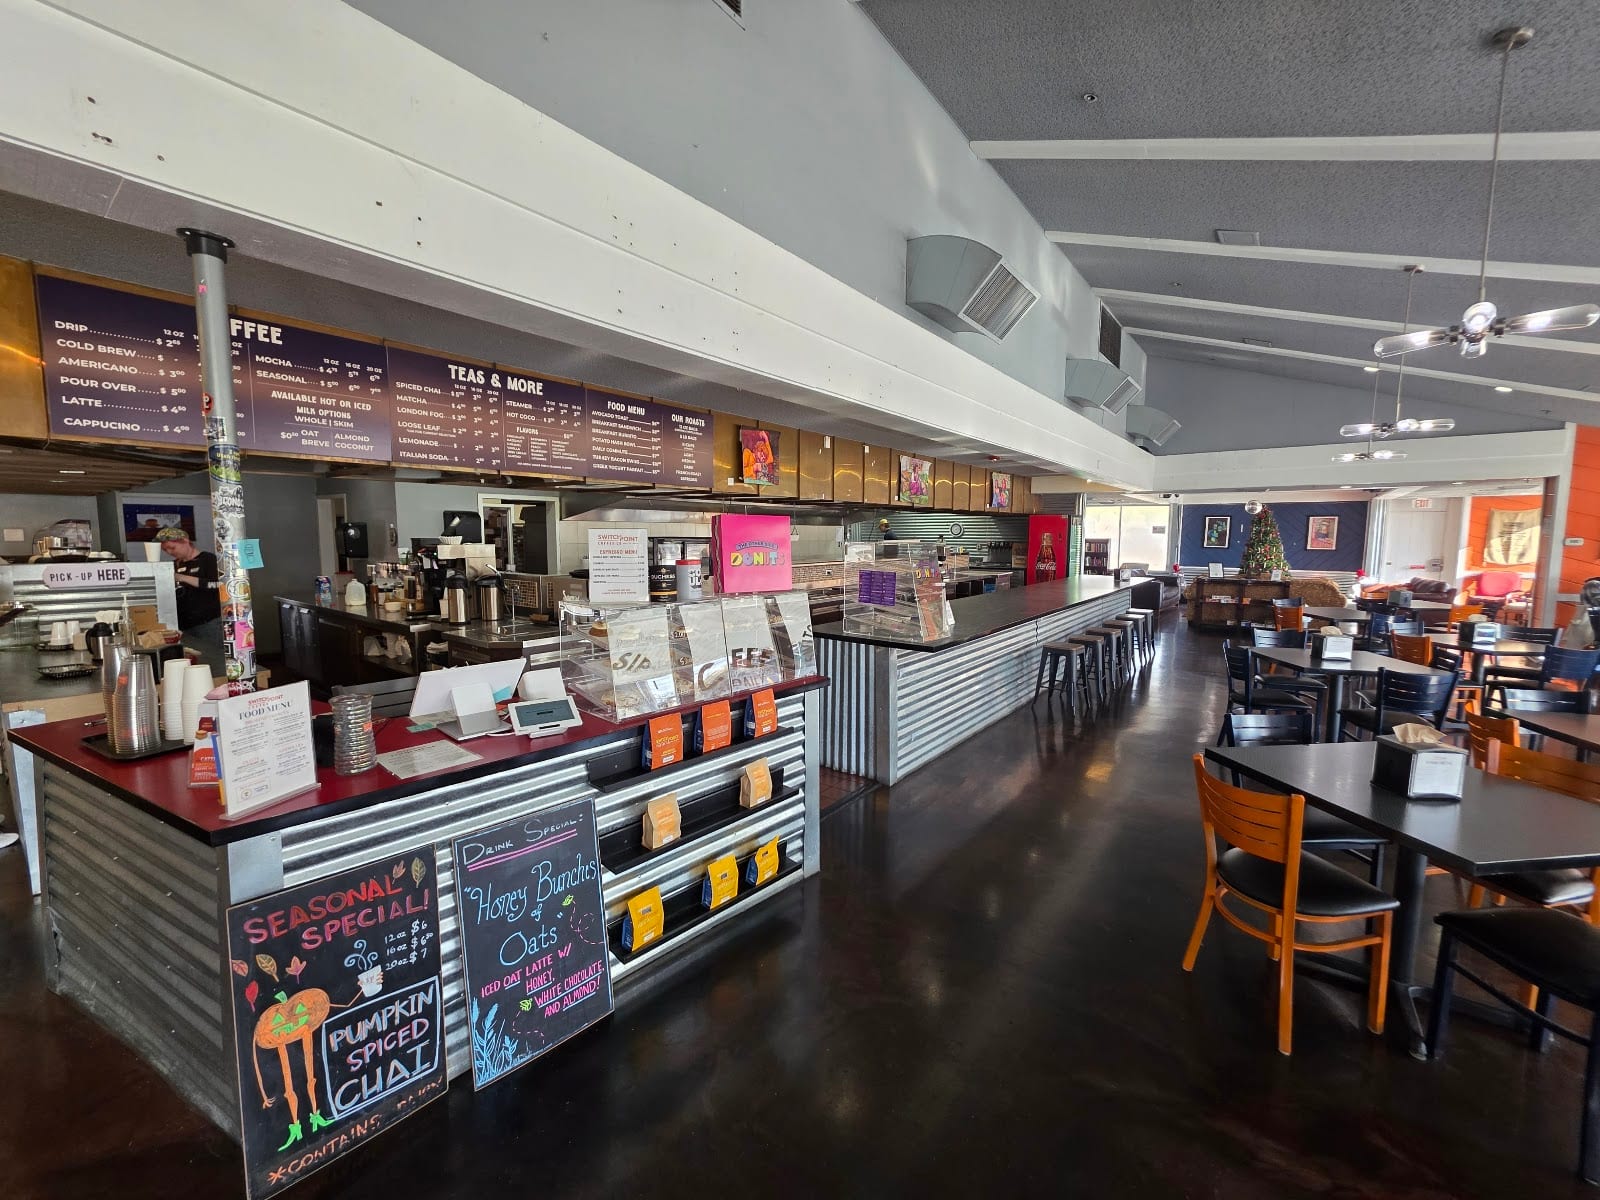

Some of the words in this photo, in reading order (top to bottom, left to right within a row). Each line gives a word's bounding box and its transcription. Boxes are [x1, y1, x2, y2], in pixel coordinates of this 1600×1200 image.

[55, 320, 88, 333] DRIP
[231, 318, 283, 345] FFEE
[56, 338, 94, 352] COLD
[97, 345, 136, 358] BREW
[59, 357, 138, 375] AMERICANO
[255, 355, 293, 368] MOCHA
[60, 376, 98, 389] POUR
[102, 381, 137, 393] OVER
[256, 370, 308, 385] SEASONAL
[448, 364, 485, 386] TEAS
[490, 373, 502, 388] &
[507, 376, 544, 396] MORE
[395, 382, 422, 391] SPICED
[424, 386, 441, 394] CHAI
[62, 395, 102, 408] LATTE
[271, 390, 317, 404] AVAILABLE
[320, 397, 337, 407] HOT
[340, 400, 352, 409] OR
[354, 401, 372, 411] ICED
[396, 395, 427, 404] MATCHA
[506, 400, 532, 409] STEAMER
[296, 406, 316, 416] MILK
[319, 409, 351, 420] OPTIONS
[397, 406, 428, 416] LONDON
[607, 401, 625, 412] FOOD
[628, 405, 645, 416] MENU
[64, 417, 140, 432] CAPPUCINO
[295, 416, 327, 426] WHOLE
[333, 420, 354, 429] SKIM
[398, 421, 422, 430] LOOSE
[423, 423, 440, 431] LEAF
[671, 413, 683, 424] OUR
[685, 416, 705, 428] ROASTS
[301, 429, 319, 437] OAT
[335, 433, 370, 442] ALMOND
[398, 437, 440, 447] LEMONADE
[302, 438, 330, 447] BREVE
[335, 442, 374, 451] COCONUT
[399, 451, 427, 460] ITALIAN
[97, 568, 126, 581] HERE
[239, 708, 265, 721] FOOD
[531, 853, 597, 902] Bunches
[243, 875, 403, 944] SEASONAL
[300, 888, 430, 950] SPECIAL!
[480, 980, 501, 998] ICED
[504, 968, 523, 987] OAT
[525, 953, 553, 977] LATTE
[534, 983, 562, 1006] WHITE
[545, 1001, 561, 1018] AND
[562, 975, 600, 1009] ALMOND!
[329, 983, 434, 1053] PUMPKIN
[346, 1018, 430, 1072] SPICED
[334, 1039, 431, 1111] CHAI
